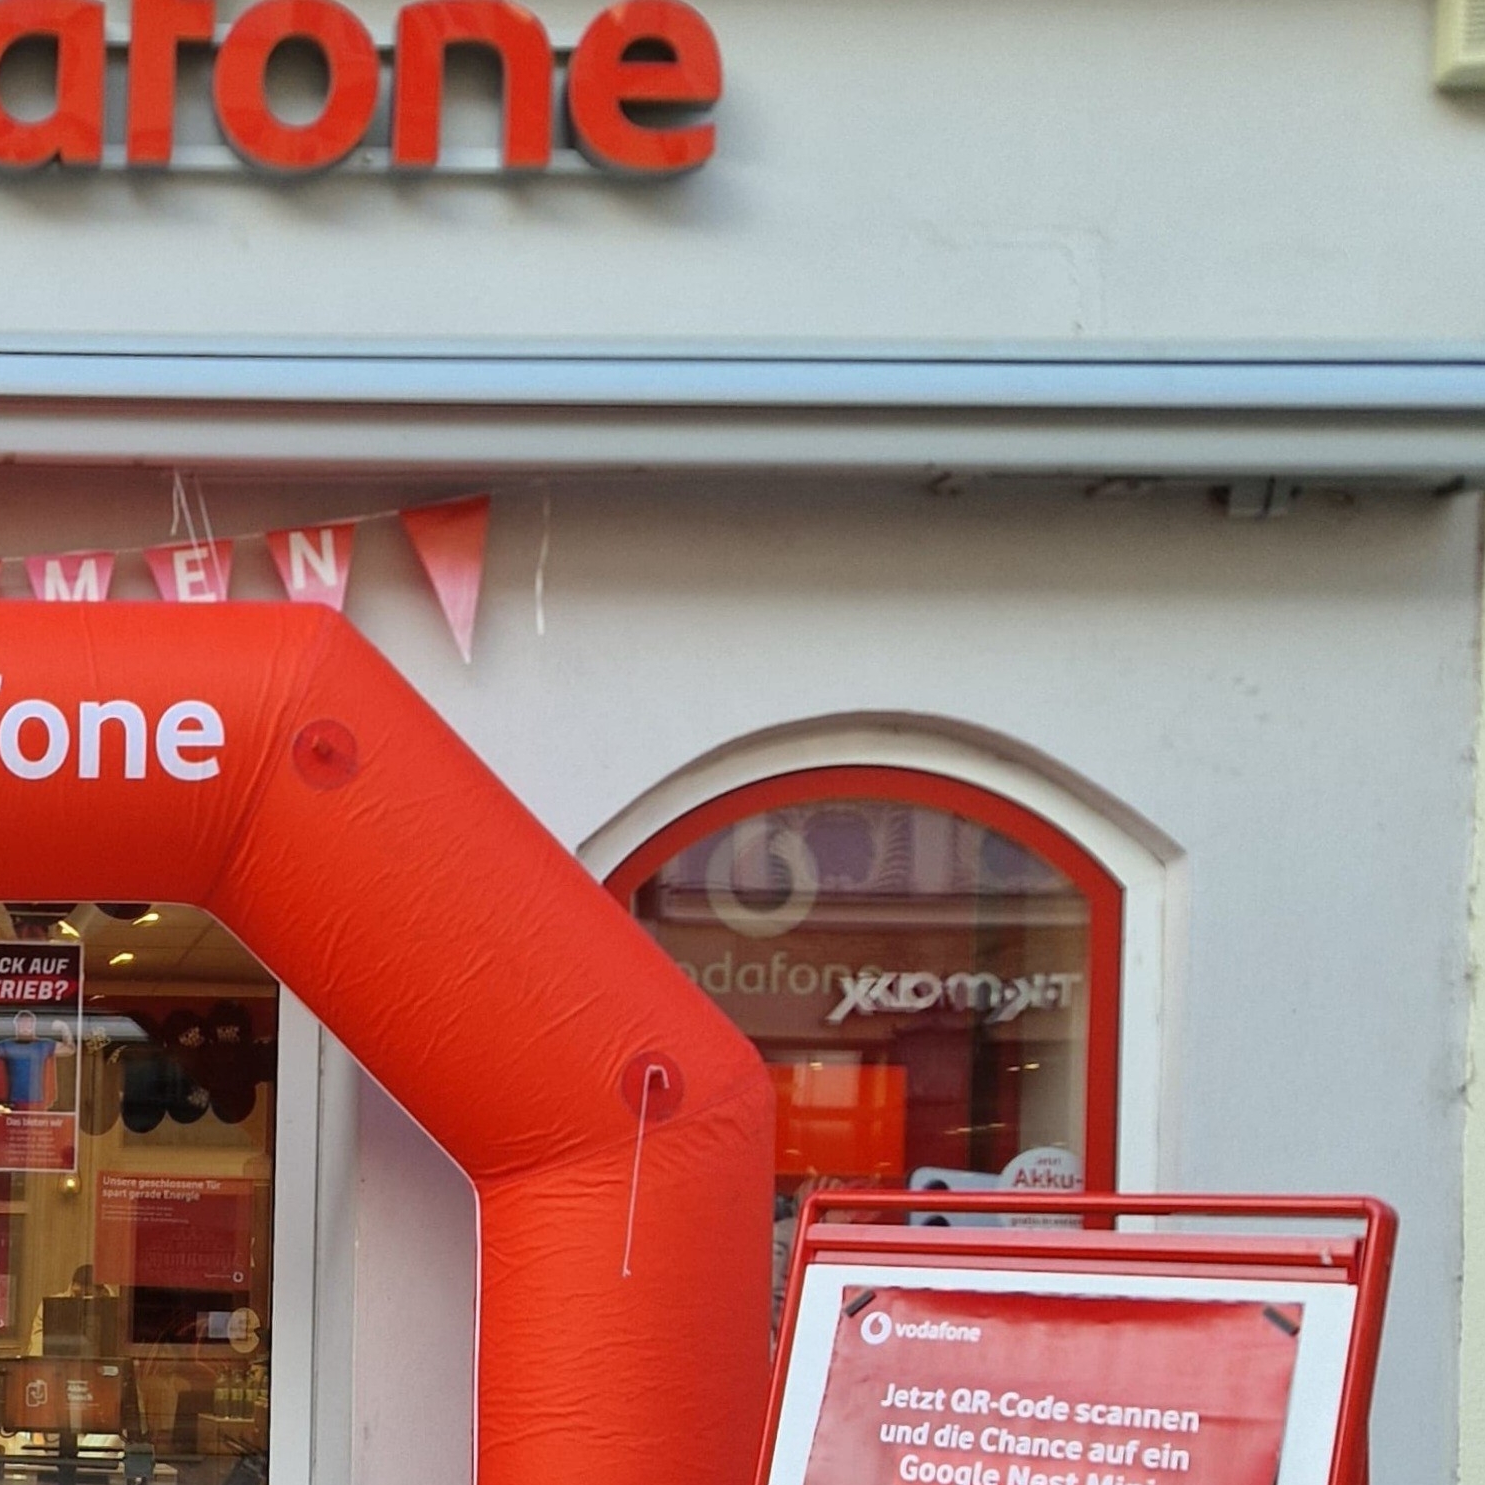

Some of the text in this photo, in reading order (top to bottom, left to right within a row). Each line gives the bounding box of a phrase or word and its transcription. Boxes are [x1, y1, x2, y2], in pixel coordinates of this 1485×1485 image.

[28, 957, 69, 975] AUF
[102, 1175, 221, 1190] Unsere geschlossene Tür
[1013, 1167, 1083, 1189] Akku-
[102, 1188, 200, 1202] spart gerade Energie
[894, 1321, 981, 1343] vodafone
[880, 1383, 1200, 1433] Jetzt QR-Code scannen
[879, 1421, 1191, 1471] und die Chance auf ein
